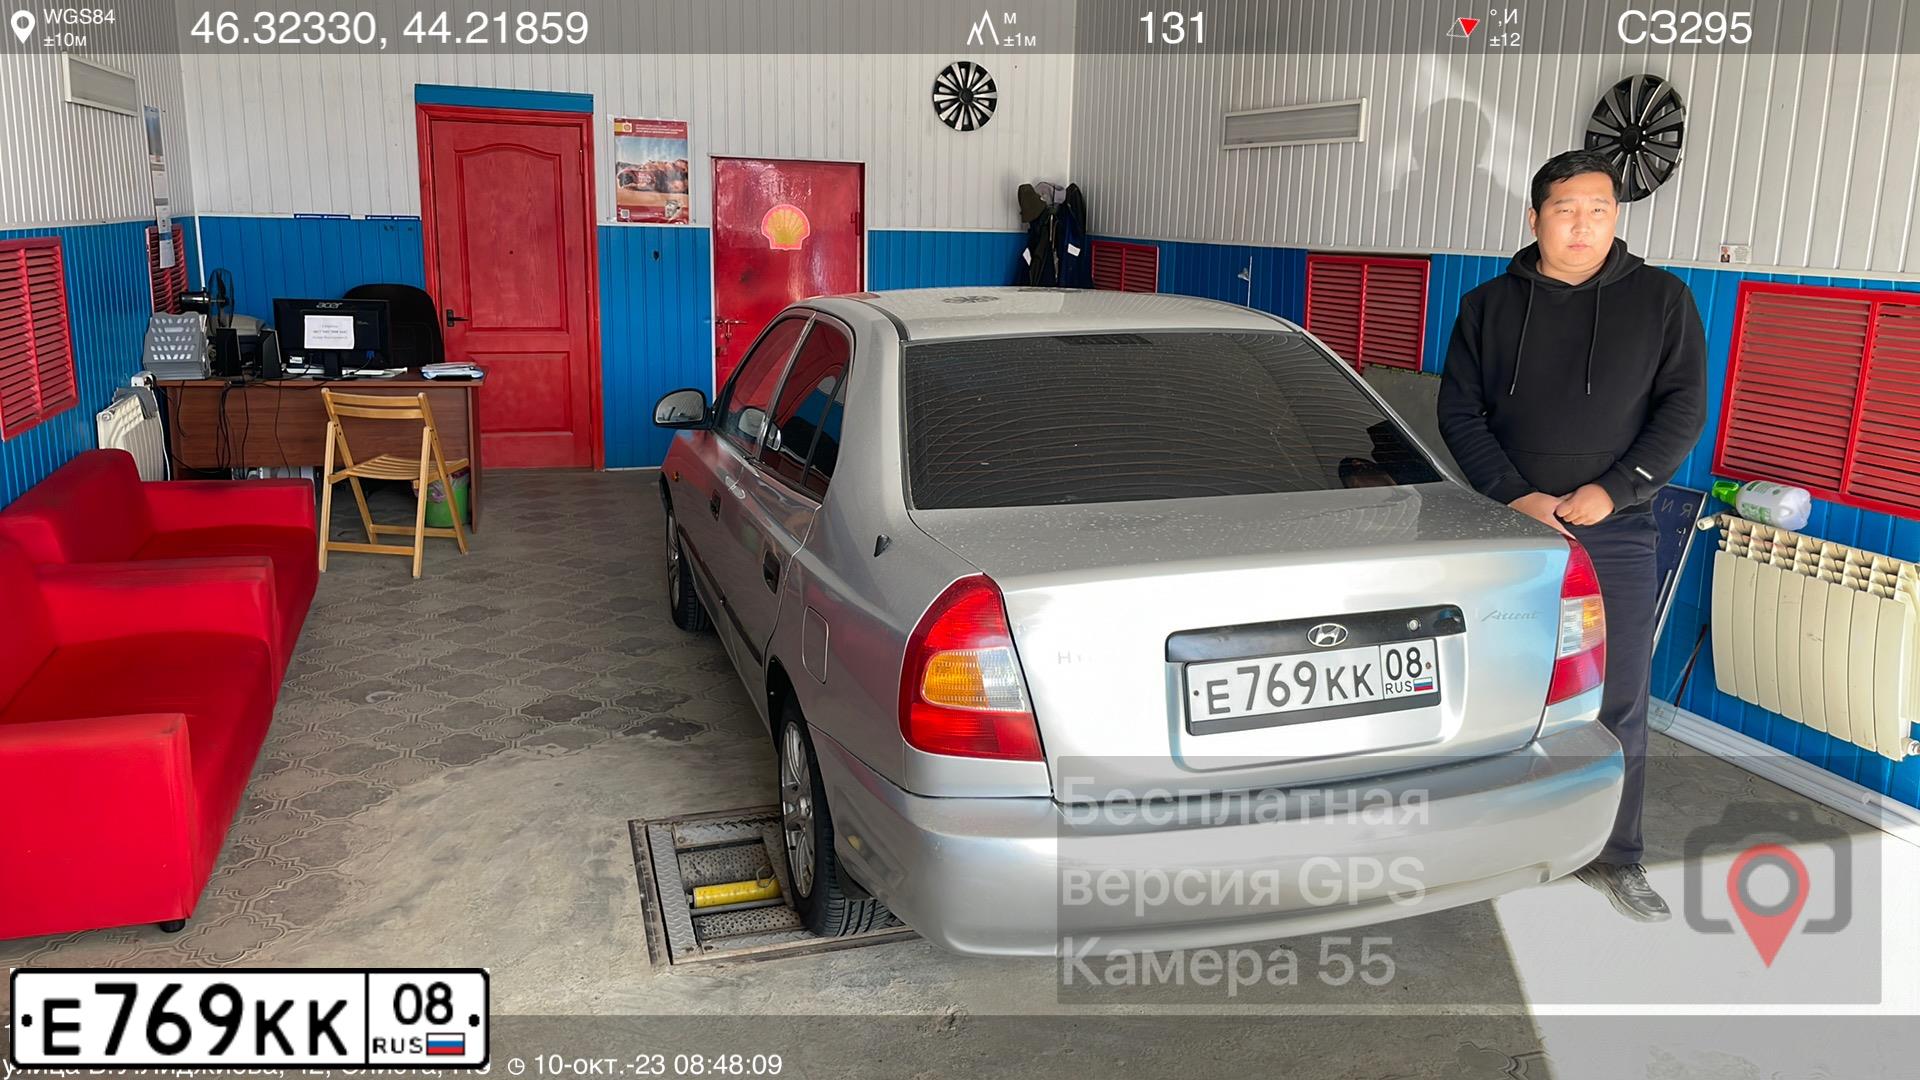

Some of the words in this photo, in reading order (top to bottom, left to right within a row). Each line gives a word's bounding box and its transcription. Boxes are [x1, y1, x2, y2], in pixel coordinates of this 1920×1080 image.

[1480, 609, 1544, 622] Accent
[1206, 660, 1375, 715] Е769КК
[1385, 646, 1423, 681] 08
[1386, 680, 1413, 694] RUS
